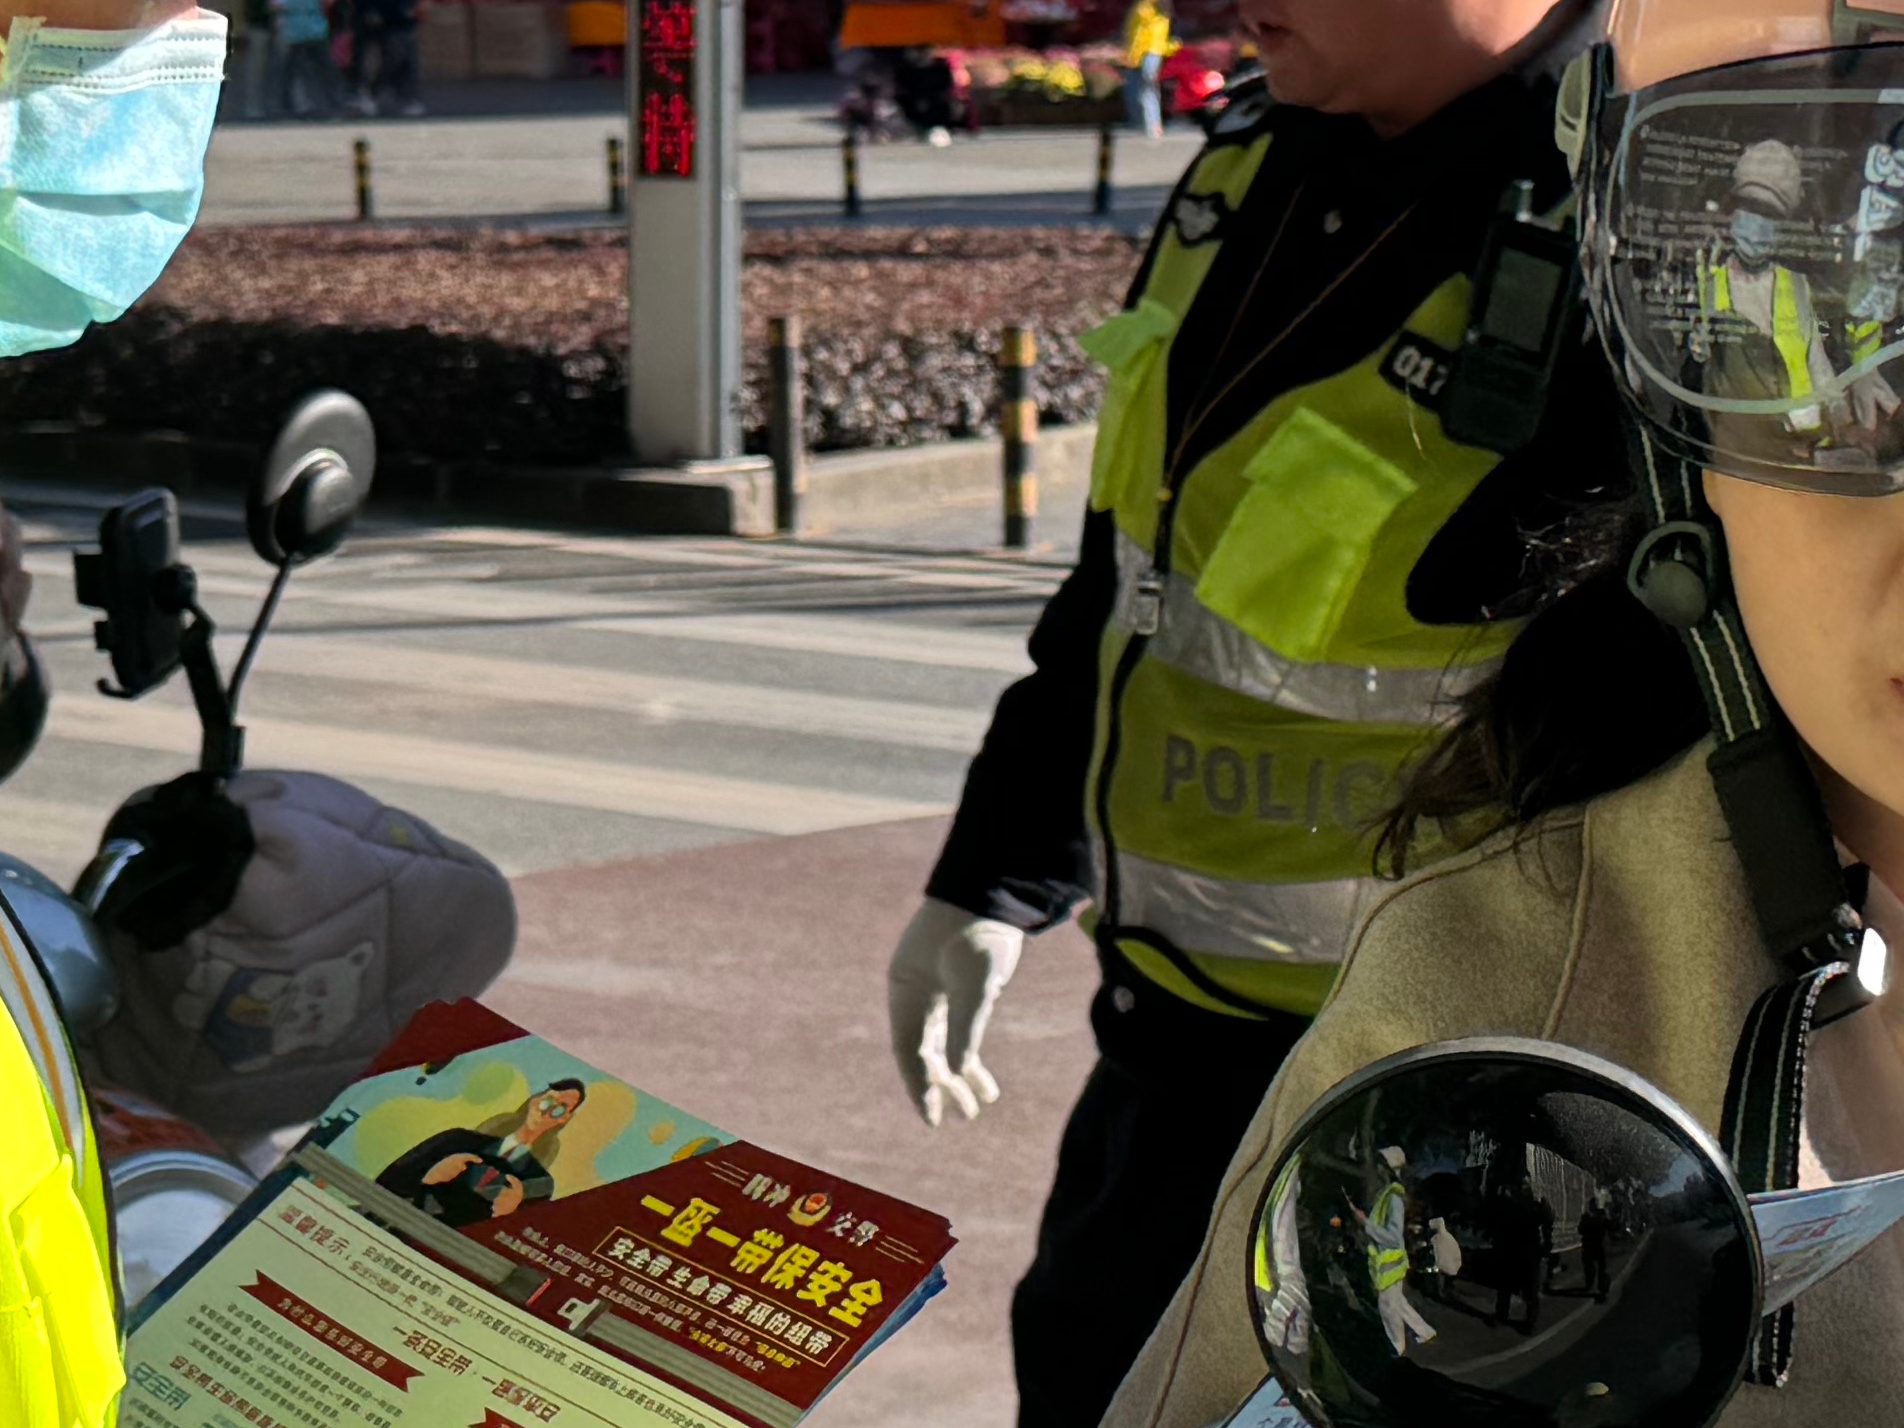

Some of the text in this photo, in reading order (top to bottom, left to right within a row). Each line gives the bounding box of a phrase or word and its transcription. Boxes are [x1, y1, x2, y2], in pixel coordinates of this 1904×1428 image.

[1161, 734, 1418, 832] POLIC
[640, 1193, 885, 1329] 一盔一带保安全
[829, 1209, 881, 1248] 交警
[606, 1236, 834, 1357] 安全带 生命带 幸福的纽带
